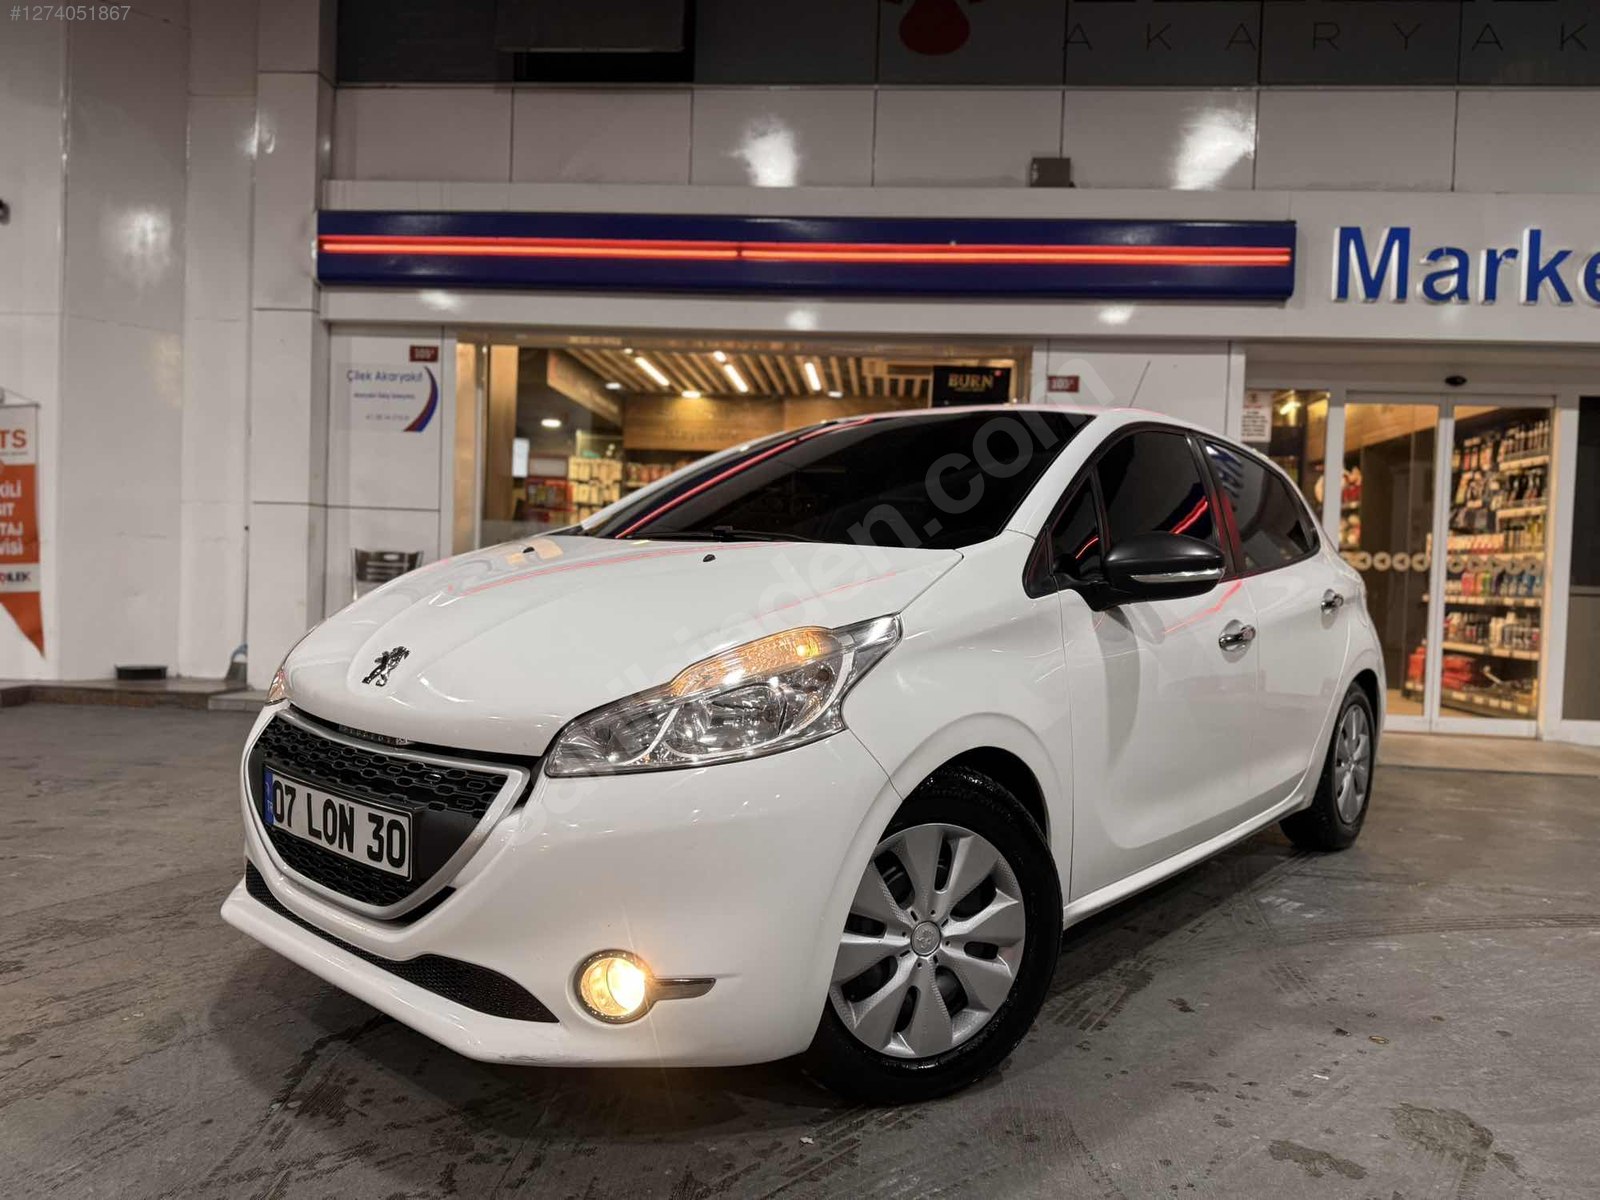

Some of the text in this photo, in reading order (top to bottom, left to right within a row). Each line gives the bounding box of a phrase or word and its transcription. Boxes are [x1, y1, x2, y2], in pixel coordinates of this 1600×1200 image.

[947, 373, 994, 388] BURN
[272, 780, 296, 828] 07
[306, 793, 355, 853] LON
[367, 812, 406, 869] 30
